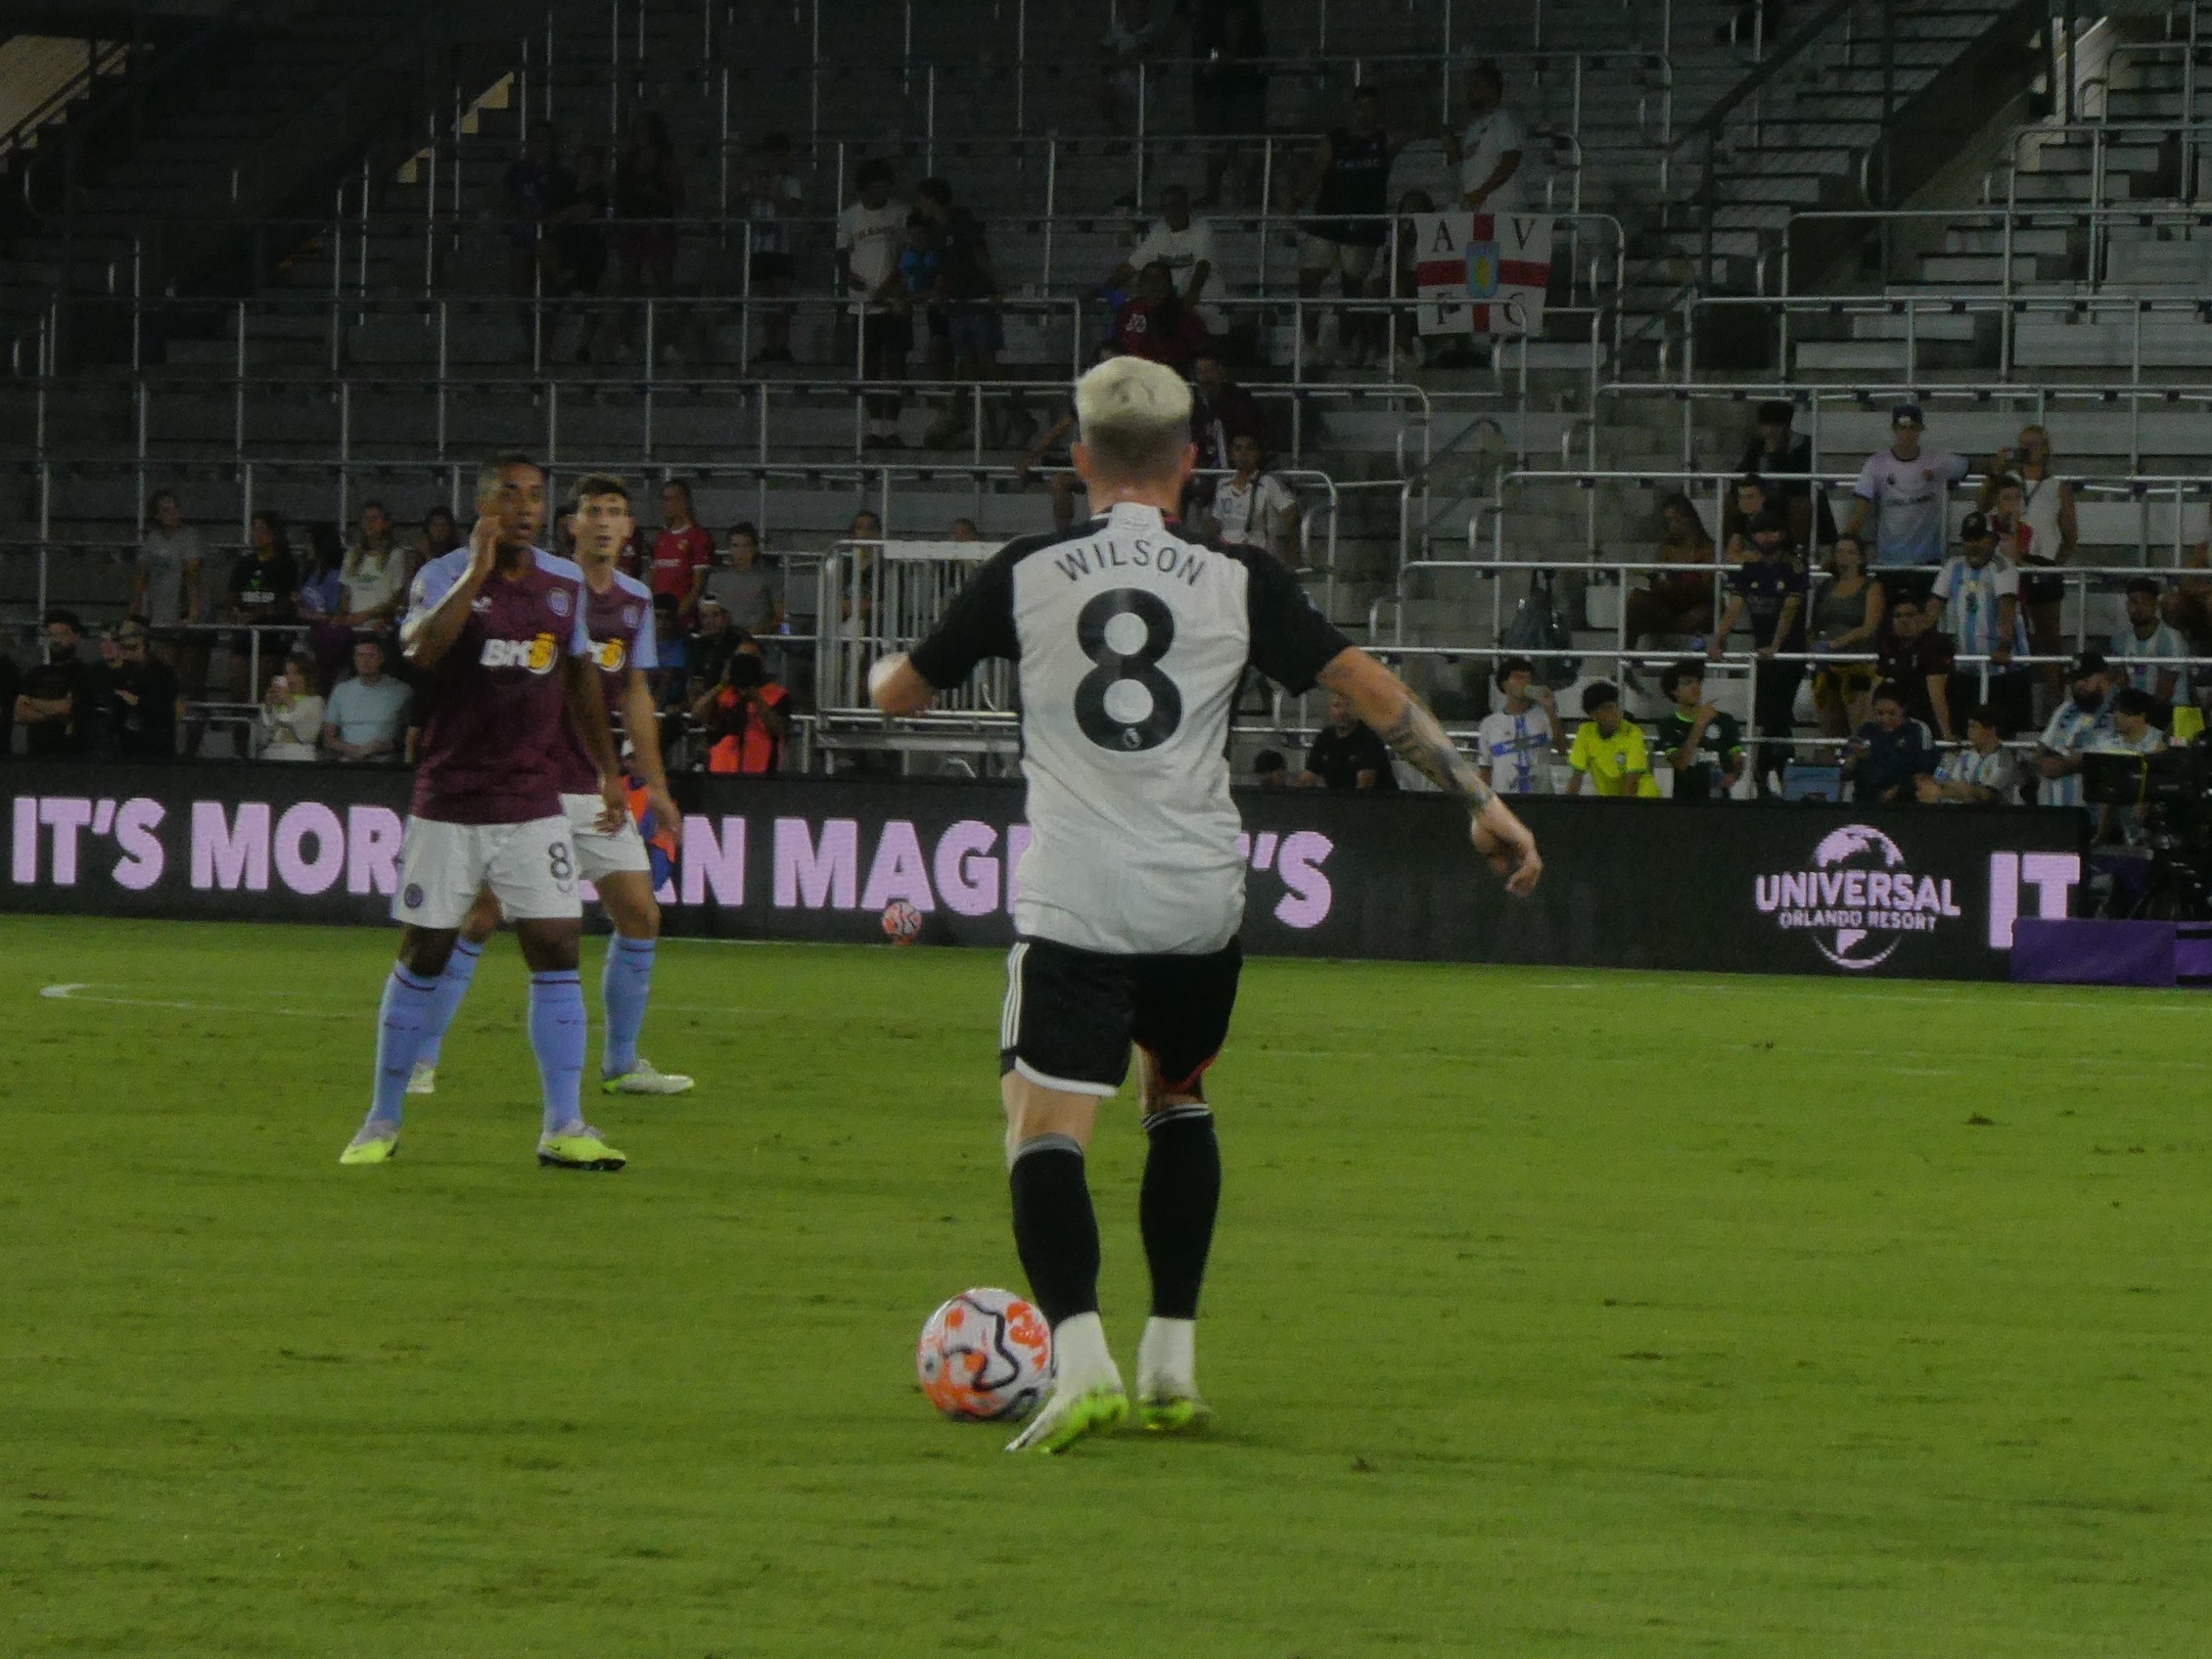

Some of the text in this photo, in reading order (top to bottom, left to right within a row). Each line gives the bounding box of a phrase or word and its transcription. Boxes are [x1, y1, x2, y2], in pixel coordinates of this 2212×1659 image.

[1433, 218, 1538, 252] A V
[1054, 539, 1207, 586] WILSON
[1074, 587, 1182, 752] 8
[12, 797, 165, 891] IT'S
[191, 801, 403, 896] MOR
[548, 842, 573, 880] 8
[1755, 869, 1960, 917] UNIVERSAL
[1989, 851, 2081, 949] IT
[1779, 910, 1936, 932] ORLANDO RESORT
